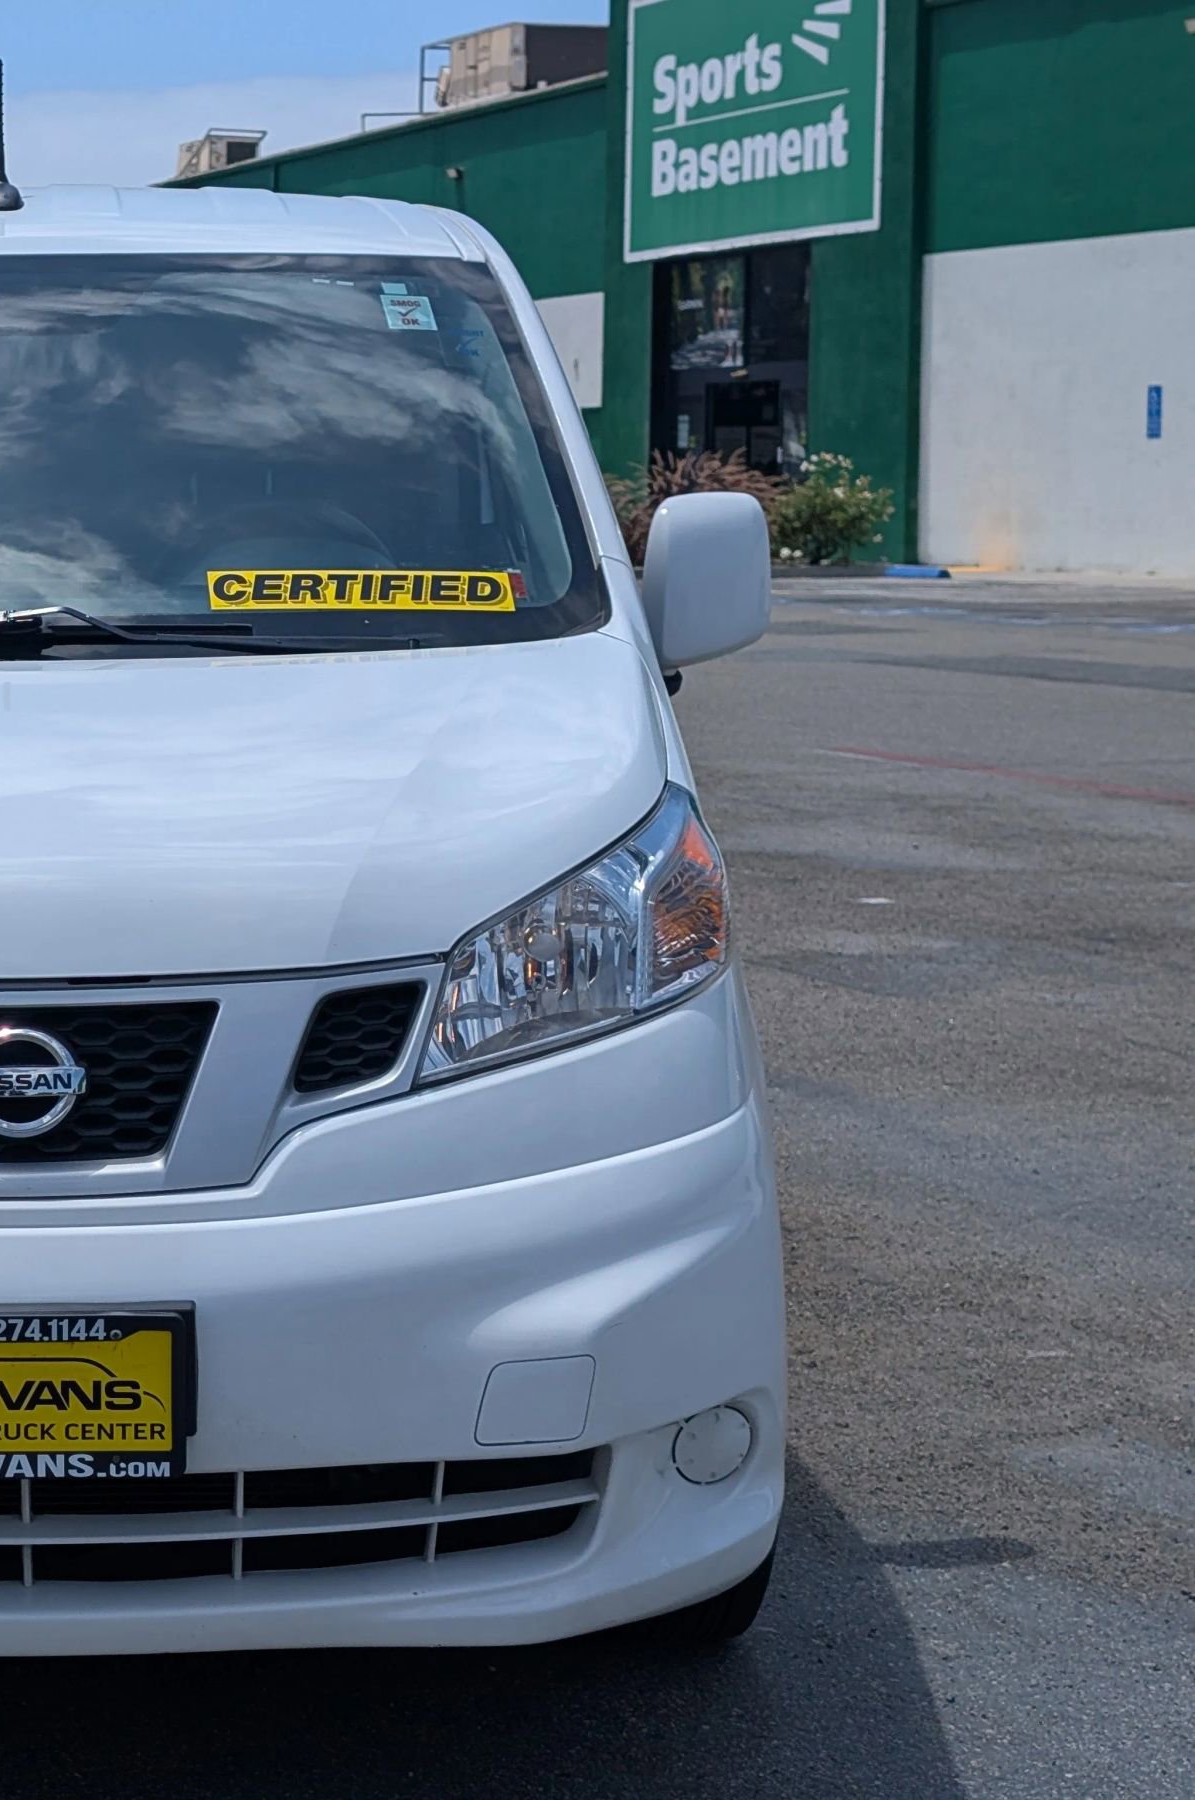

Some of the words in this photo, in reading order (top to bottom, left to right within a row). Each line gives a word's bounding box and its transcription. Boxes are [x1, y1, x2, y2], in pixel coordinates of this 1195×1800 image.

[653, 33, 782, 125] Sports
[651, 103, 849, 197] Basement
[400, 318, 421, 326] OK
[212, 573, 507, 604] CERTIFIED
[64, 1423, 166, 1440] CENTER
